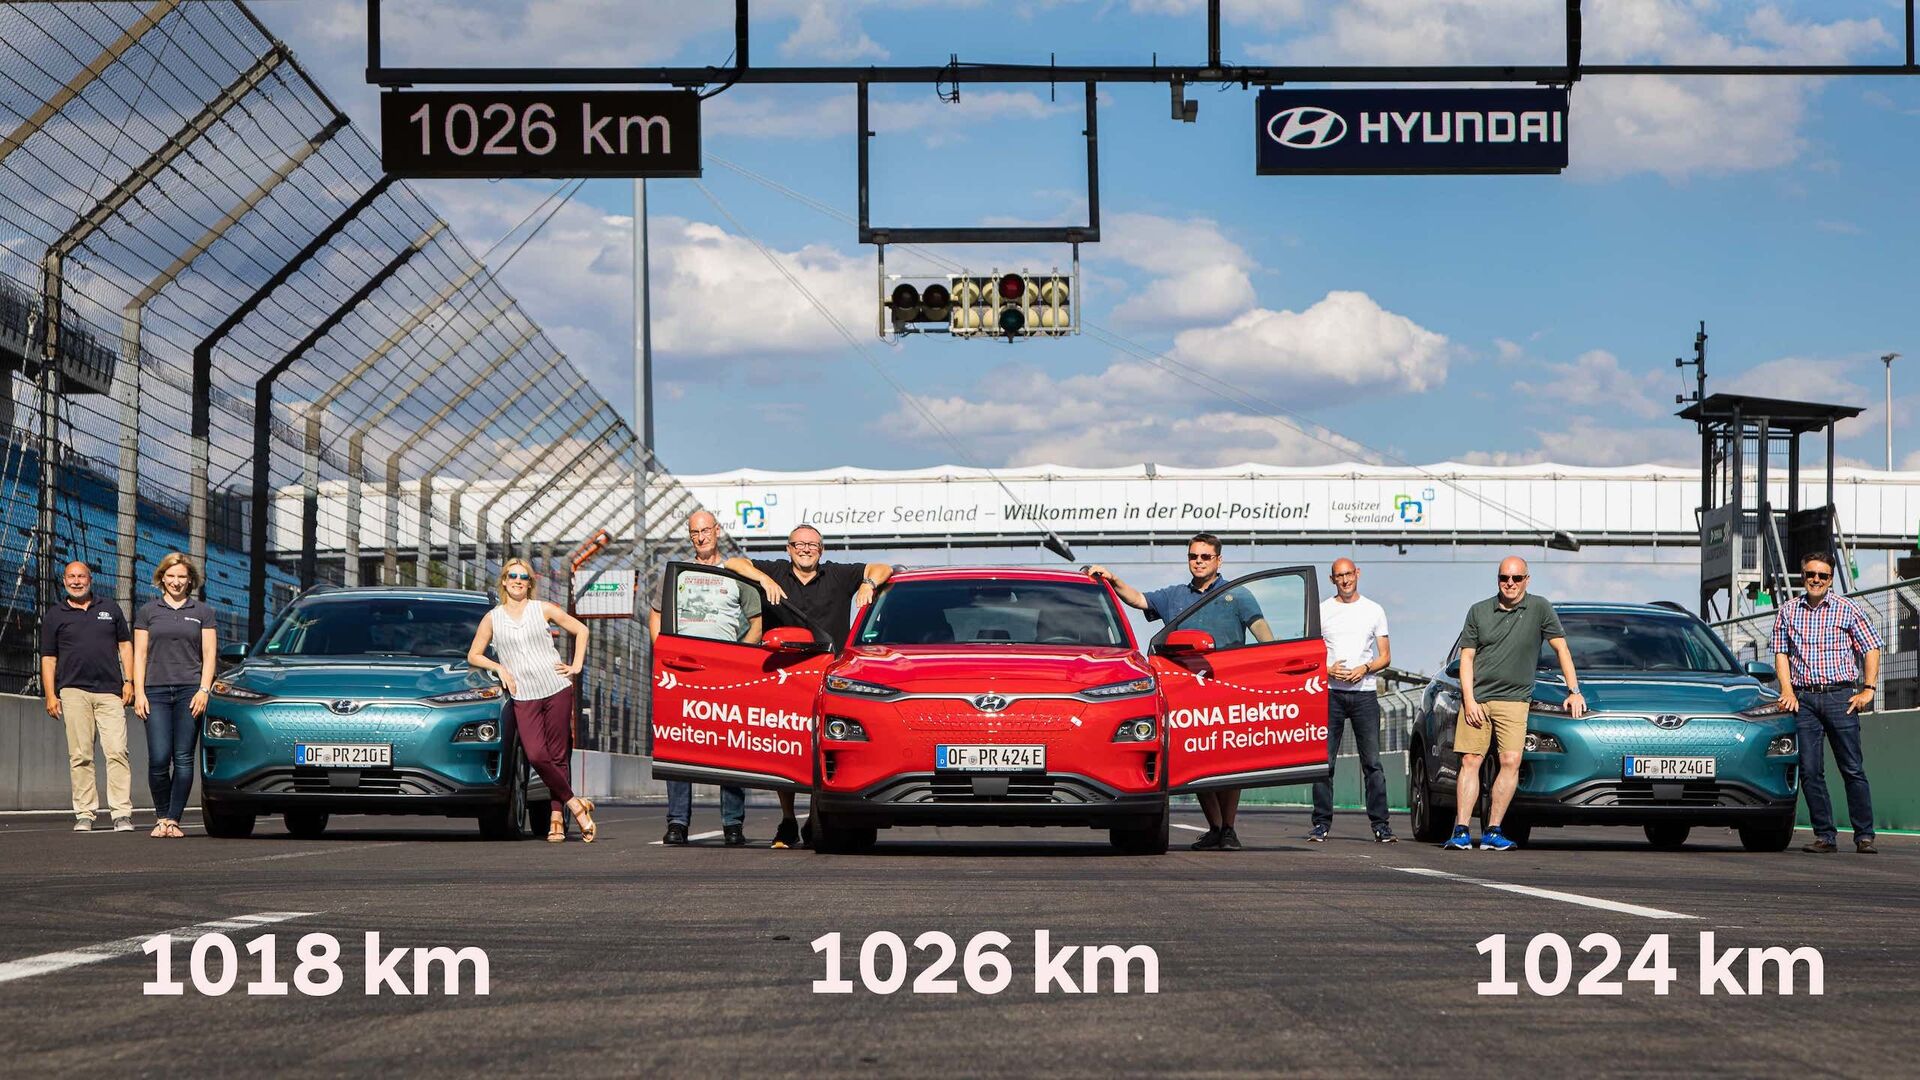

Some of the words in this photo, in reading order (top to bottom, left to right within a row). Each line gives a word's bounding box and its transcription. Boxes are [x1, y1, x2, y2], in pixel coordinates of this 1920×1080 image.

[410, 102, 557, 155] 1026
[583, 102, 671, 154] km
[1361, 111, 1561, 143] HYUNDAI
[801, 507, 885, 524] Lausitzer
[892, 504, 978, 522] Seenland
[1003, 503, 1117, 520] Willkommen
[1123, 502, 1140, 519] in
[1146, 502, 1177, 518] der
[1181, 502, 1310, 519] Pool-Position!
[1331, 500, 1380, 511] Lausitzer
[1344, 513, 1395, 523] Seenland
[682, 699, 743, 724] KONA
[1228, 701, 1300, 724] Elektro
[1184, 730, 1218, 753] auf
[1222, 721, 1329, 750] Reichweite
[306, 747, 323, 762] OF
[333, 748, 350, 762] PR
[948, 748, 967, 765] OF
[979, 749, 998, 765] PR
[1635, 759, 1651, 774] OF
[1661, 759, 1676, 774] PR
